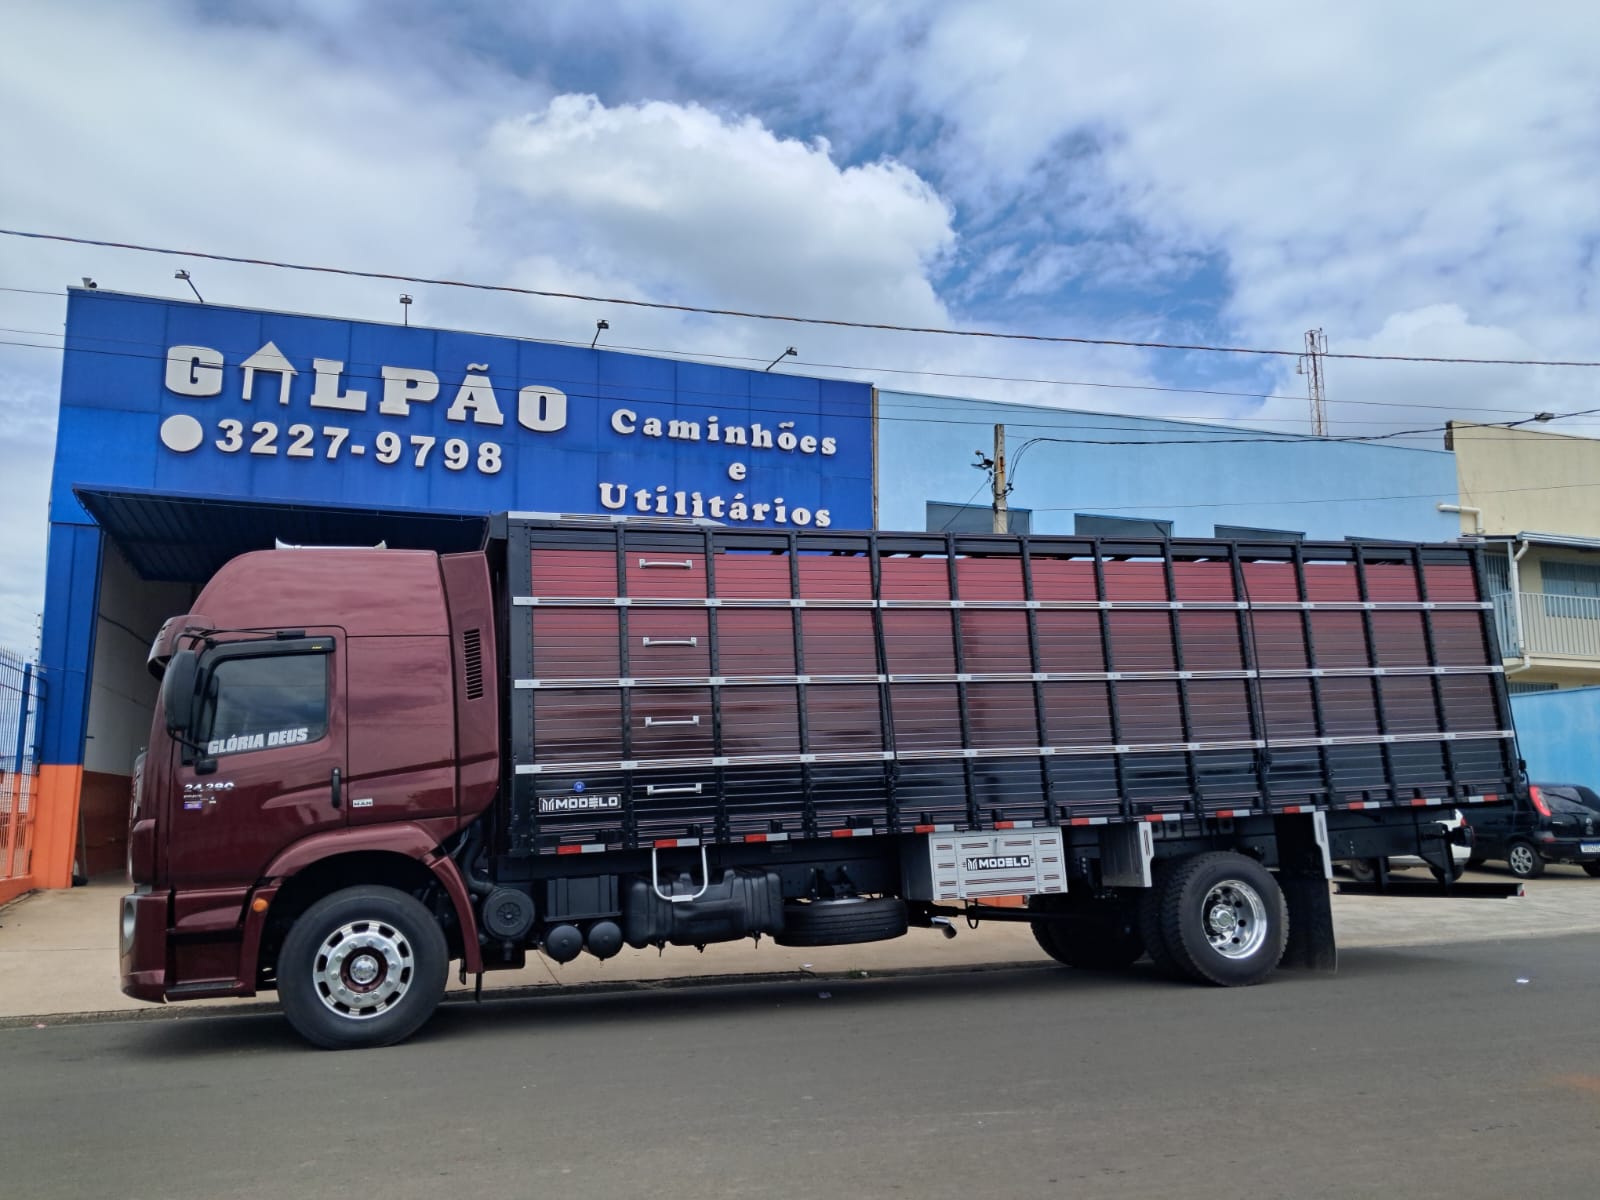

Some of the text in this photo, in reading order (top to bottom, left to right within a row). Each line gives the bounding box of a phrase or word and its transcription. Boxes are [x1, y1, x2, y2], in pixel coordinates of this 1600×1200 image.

[611, 409, 837, 455] Caminhões
[215, 419, 502, 474] 3227-9798
[728, 462, 747, 481] e
[599, 483, 831, 528] Utilitários
[207, 728, 308, 755] GLÓRIA DEUS
[555, 796, 619, 810] MODELO
[978, 856, 1030, 869] MODELO
